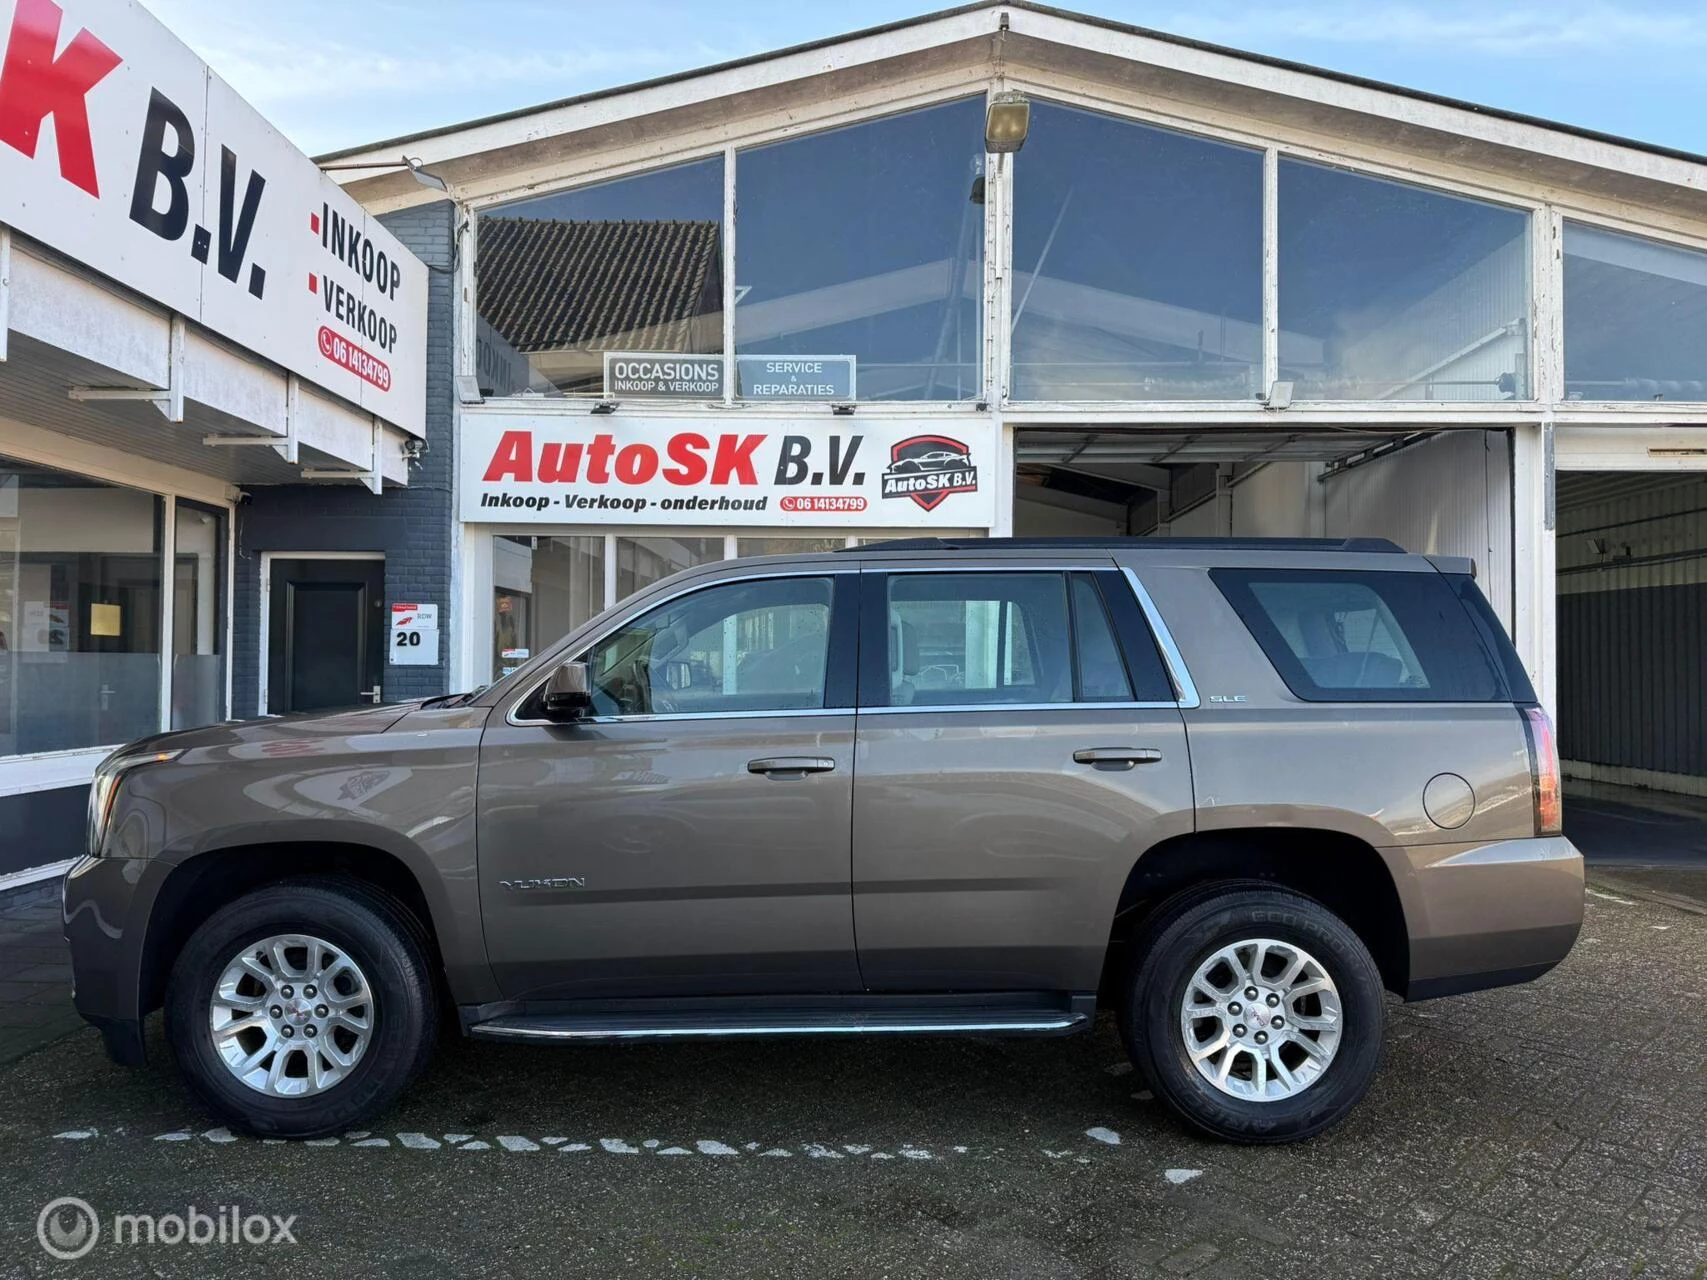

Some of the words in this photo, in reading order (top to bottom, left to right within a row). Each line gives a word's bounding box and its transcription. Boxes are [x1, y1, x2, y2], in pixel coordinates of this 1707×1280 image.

[129, 86, 266, 300] B.V.
[322, 202, 401, 301] INKOOP
[323, 275, 398, 354] VERKOOP
[332, 336, 347, 362] 06
[348, 346, 390, 389] 14134799
[614, 362, 719, 381] OCCASIONS
[766, 362, 822, 373] SERVICE
[614, 380, 655, 391] INKOOP
[657, 381, 666, 391] &
[667, 381, 719, 393] VERKOOP
[753, 384, 835, 395] REPARATIES
[481, 430, 769, 486] AutoSK
[773, 435, 867, 486] B.V.
[884, 473, 952, 494] AutoSK
[953, 471, 976, 487] B.V.
[481, 492, 551, 511] Inkoop
[564, 494, 648, 513] Verkoop
[660, 495, 769, 512] onderhoud
[796, 498, 812, 510] 06
[812, 497, 865, 510] 14134799
[396, 631, 421, 647] 20
[1209, 695, 1247, 704] SLE
[499, 877, 585, 890] YUKON
